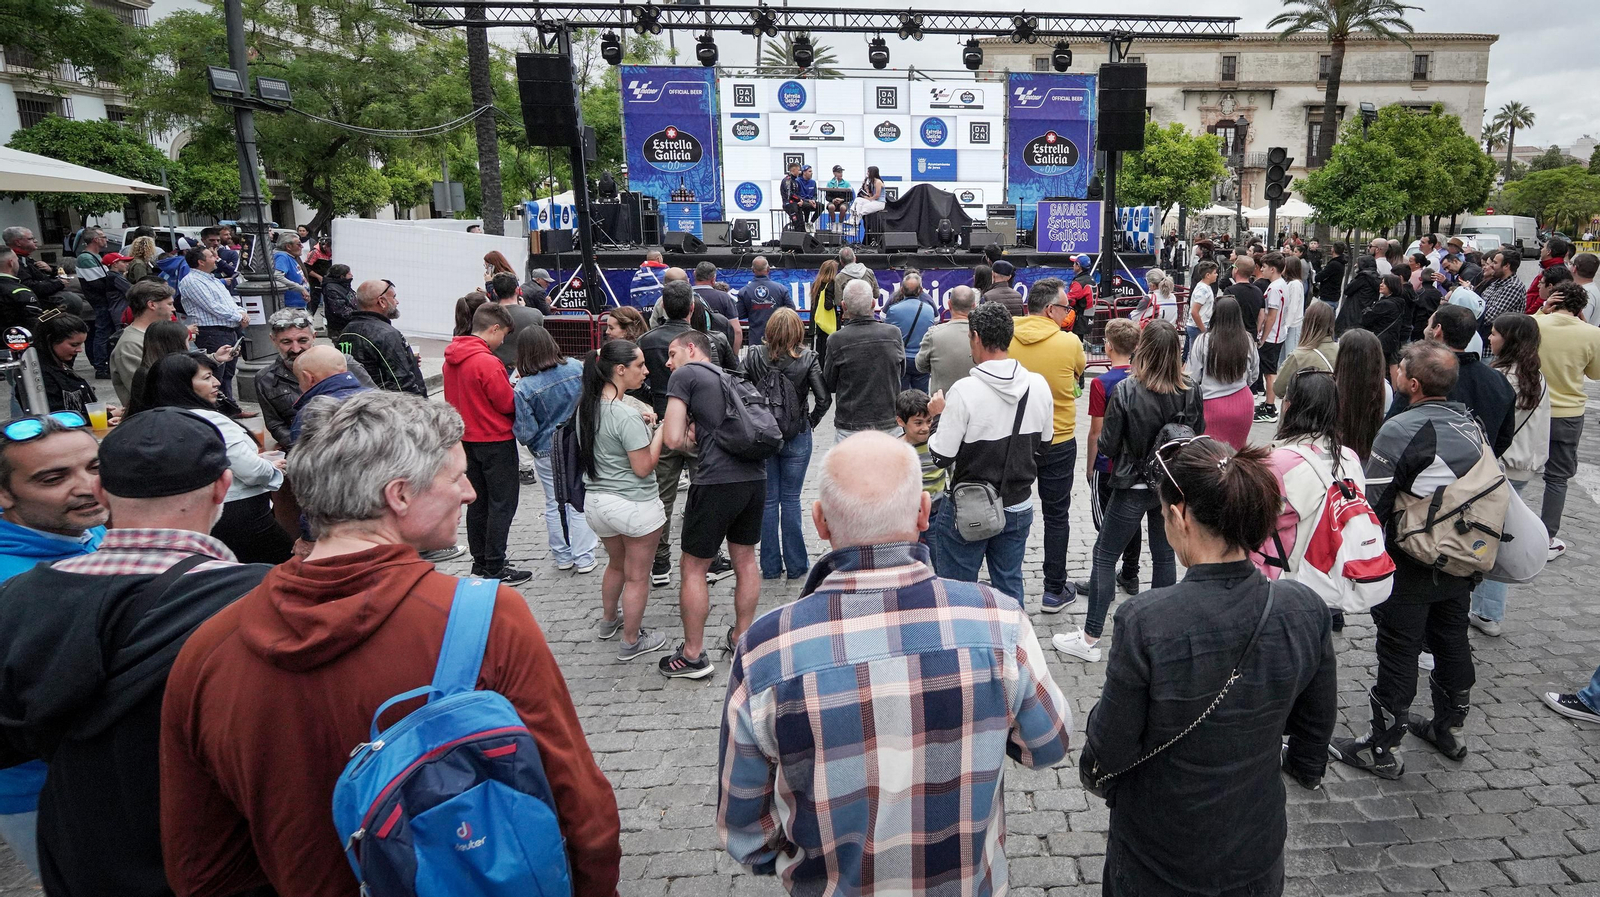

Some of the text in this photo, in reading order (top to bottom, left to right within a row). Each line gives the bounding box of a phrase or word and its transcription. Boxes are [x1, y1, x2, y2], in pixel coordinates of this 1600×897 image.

[652, 139, 692, 150] Estrella
[1032, 143, 1070, 154] Estrella
[654, 150, 691, 160] Galicia
[1034, 154, 1068, 164] Galicia
[1050, 204, 1088, 216] GARAGE
[1047, 216, 1091, 229] Estrella
[1048, 228, 1089, 241] Galicia
[1112, 286, 1134, 295] rella
[560, 298, 587, 307] Galic
